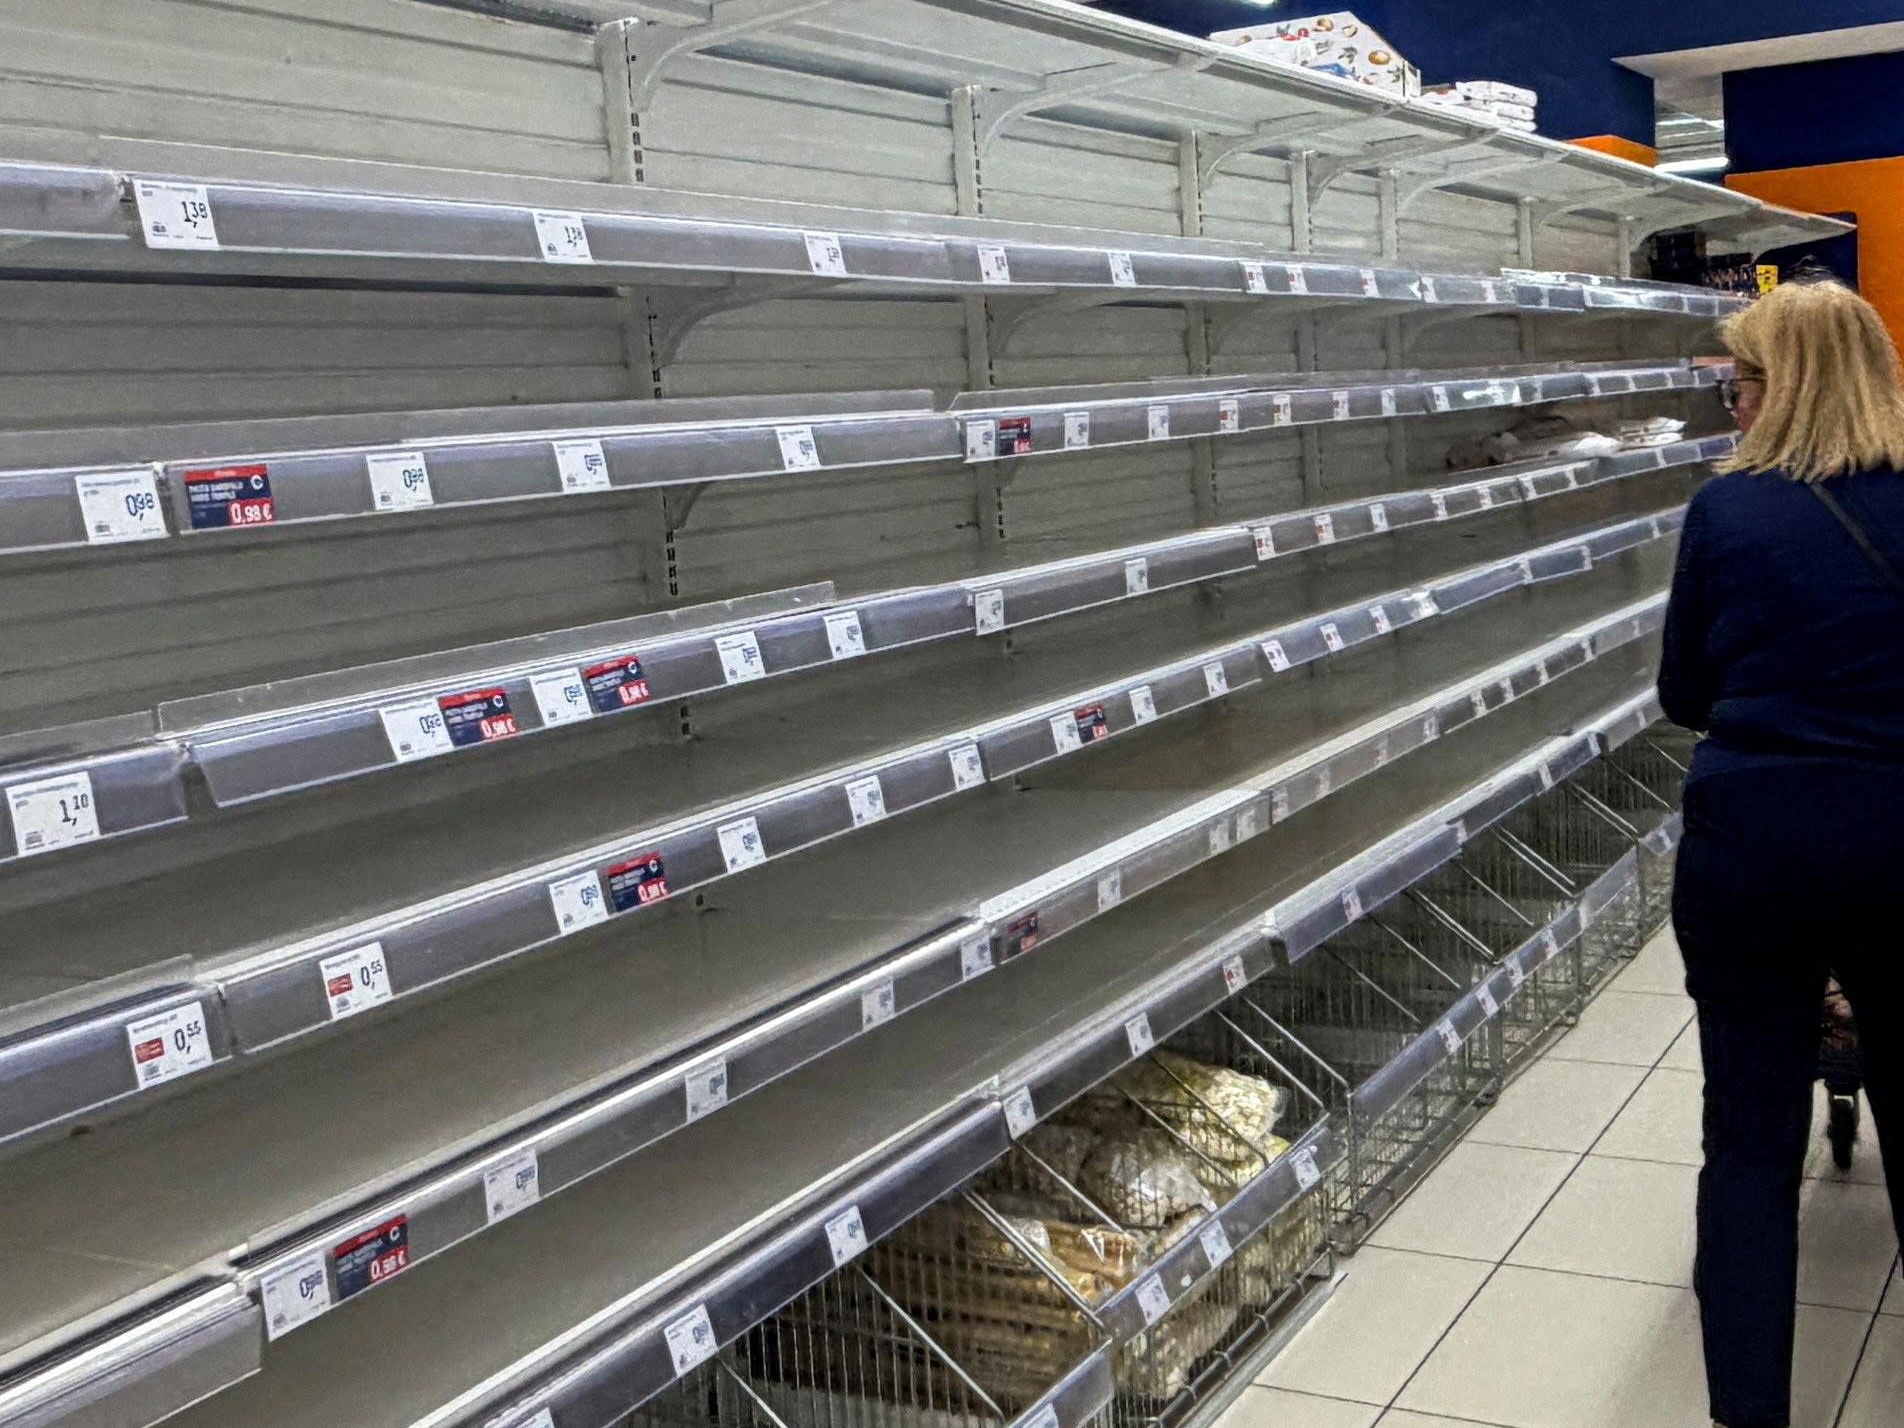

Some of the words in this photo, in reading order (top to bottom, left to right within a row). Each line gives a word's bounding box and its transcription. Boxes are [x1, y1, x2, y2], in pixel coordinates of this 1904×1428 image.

[59, 794, 91, 827] 1,10
[360, 959, 384, 990] 0,55
[174, 1019, 202, 1055] 0,55
